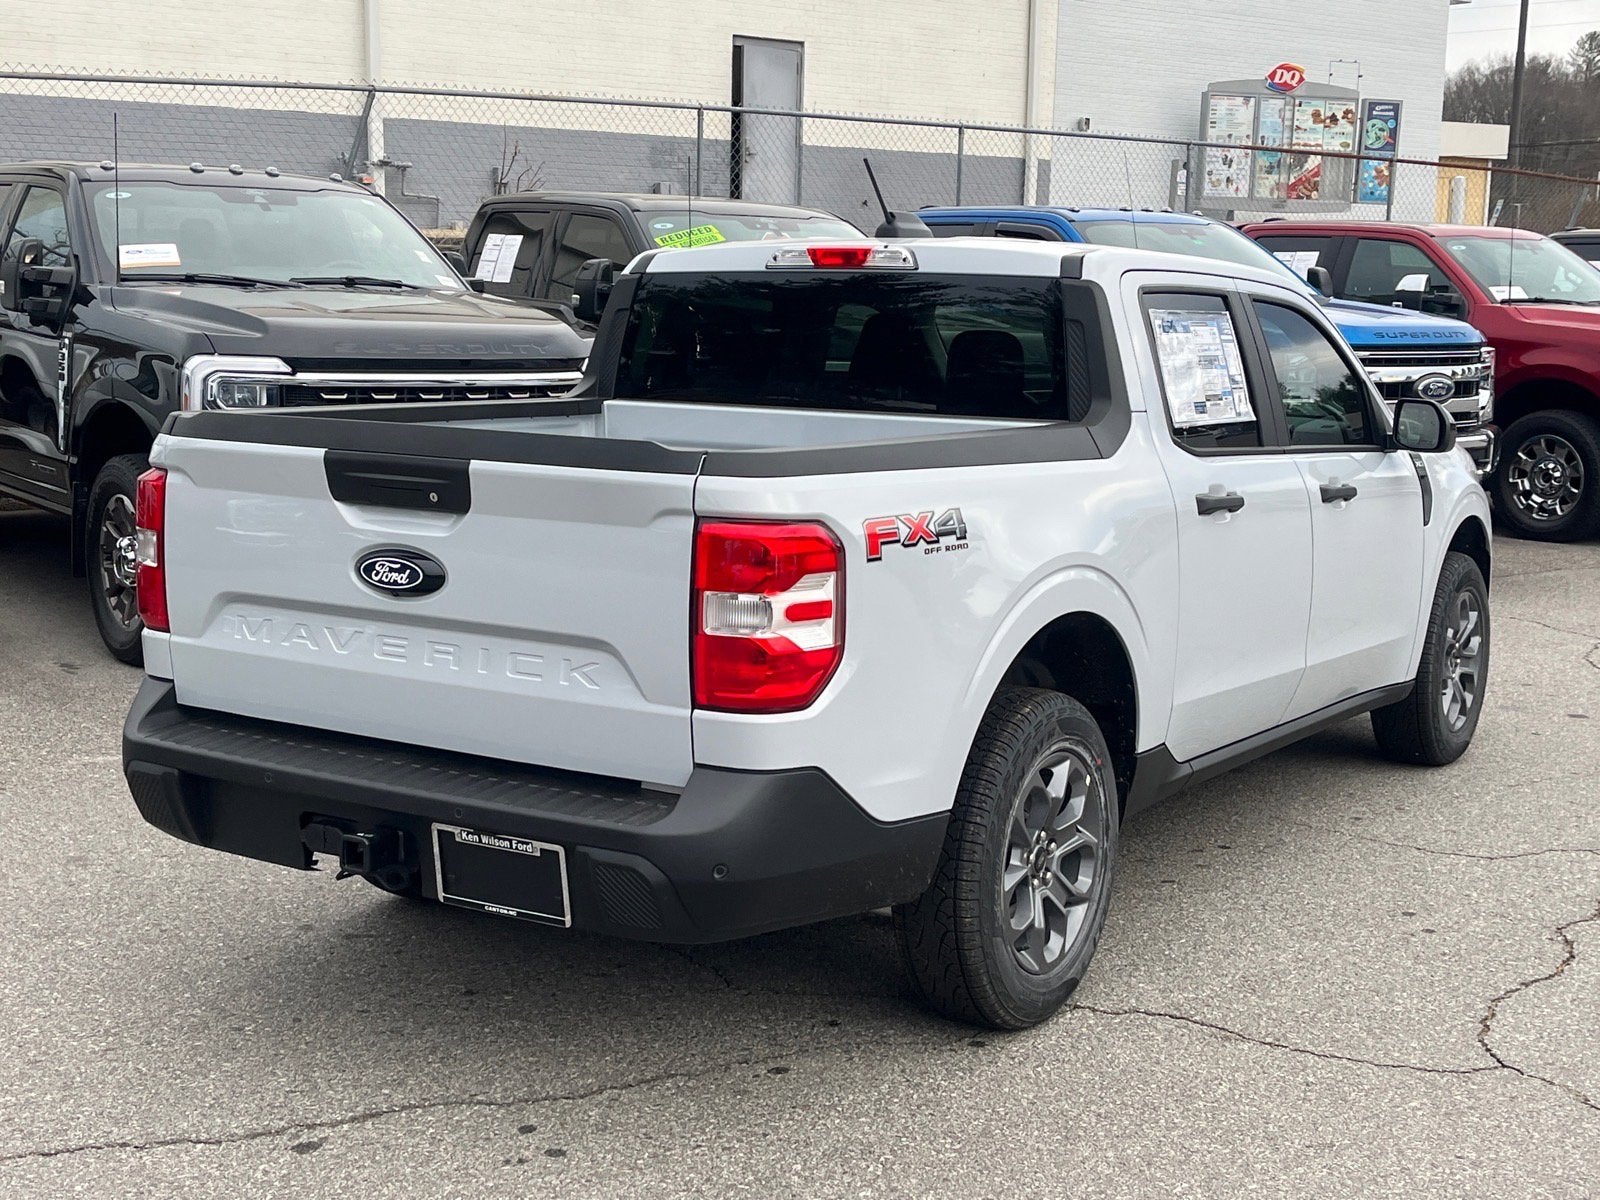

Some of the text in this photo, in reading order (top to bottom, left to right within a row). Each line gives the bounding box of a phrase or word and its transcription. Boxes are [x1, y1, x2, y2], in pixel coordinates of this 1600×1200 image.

[1273, 68, 1300, 87] DQ
[660, 226, 712, 244] REDUCED
[1373, 331, 1431, 339] SUPER
[465, 344, 549, 355] DUTY
[1427, 382, 1448, 396] Ford
[862, 507, 967, 563] FX4
[924, 542, 969, 555] OFF ROAD
[371, 561, 410, 586] Ford
[234, 614, 601, 690] MAVERICK
[461, 830, 533, 853] Ken Wilson Ford
